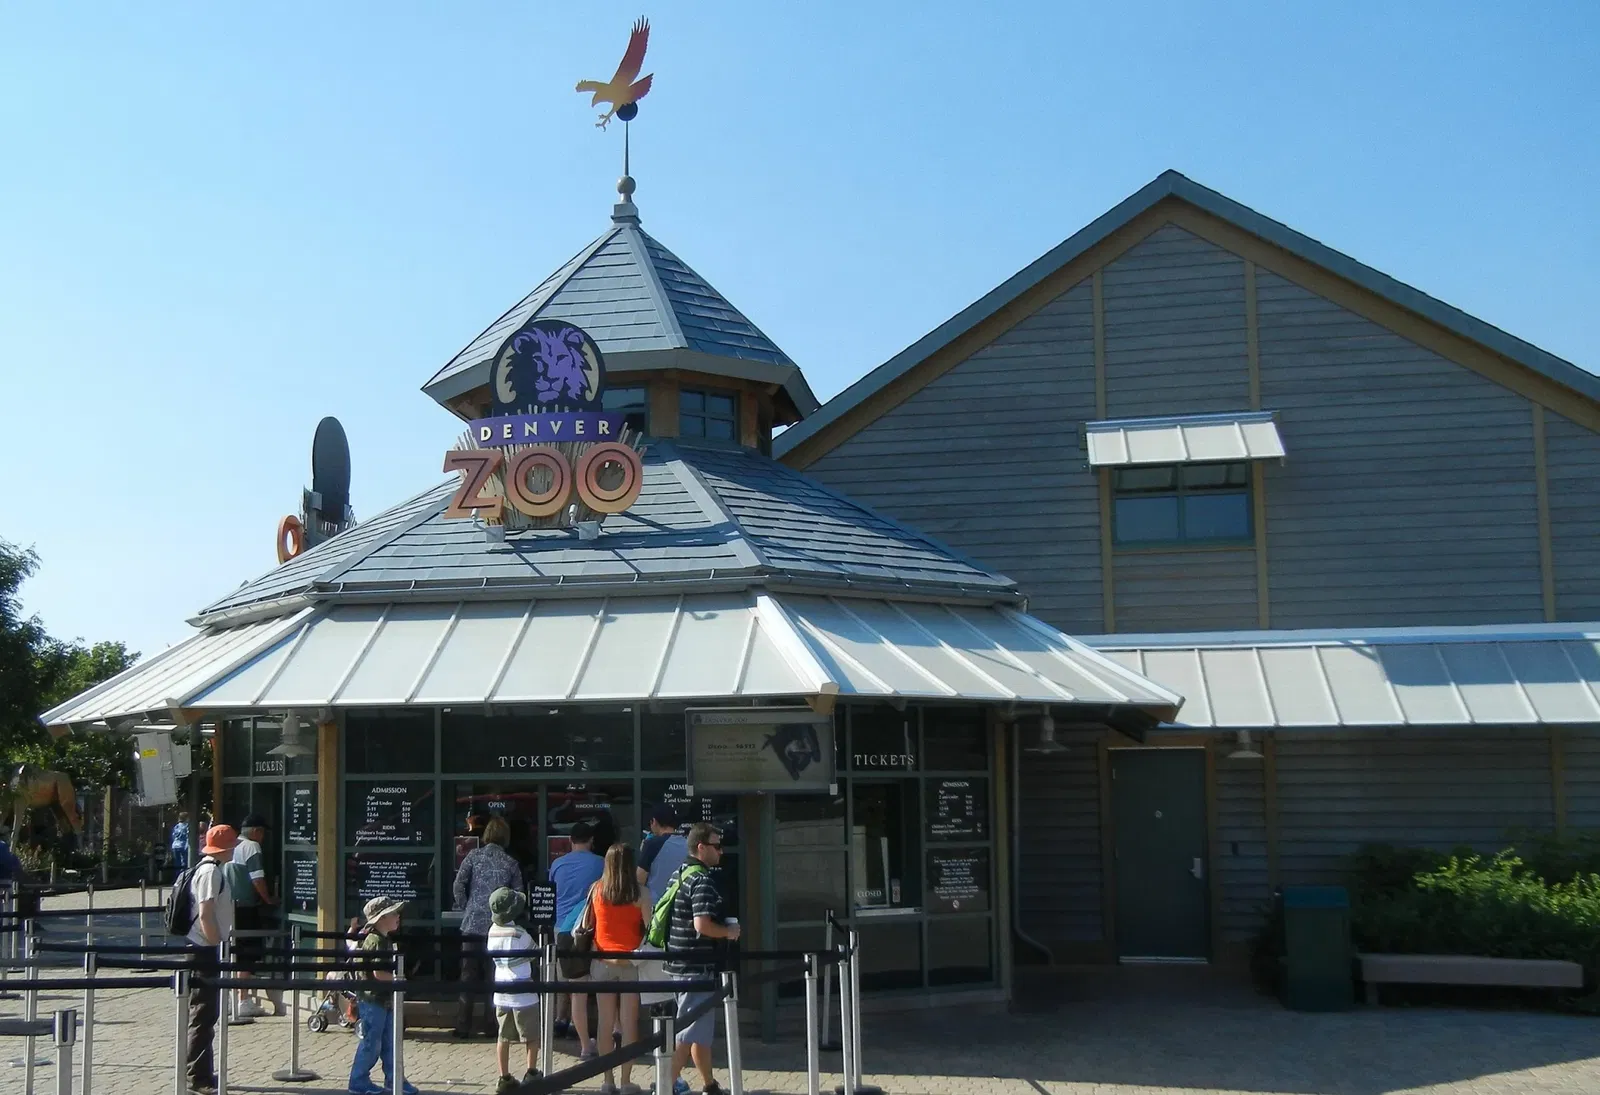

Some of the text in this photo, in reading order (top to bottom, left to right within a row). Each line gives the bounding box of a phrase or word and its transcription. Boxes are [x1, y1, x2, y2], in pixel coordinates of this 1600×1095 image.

[480, 420, 610, 441] DENVER
[443, 442, 643, 520] ZOO
[256, 760, 284, 772] TICKETS
[498, 755, 575, 768] TICKETS
[854, 754, 914, 766] TICKETS
